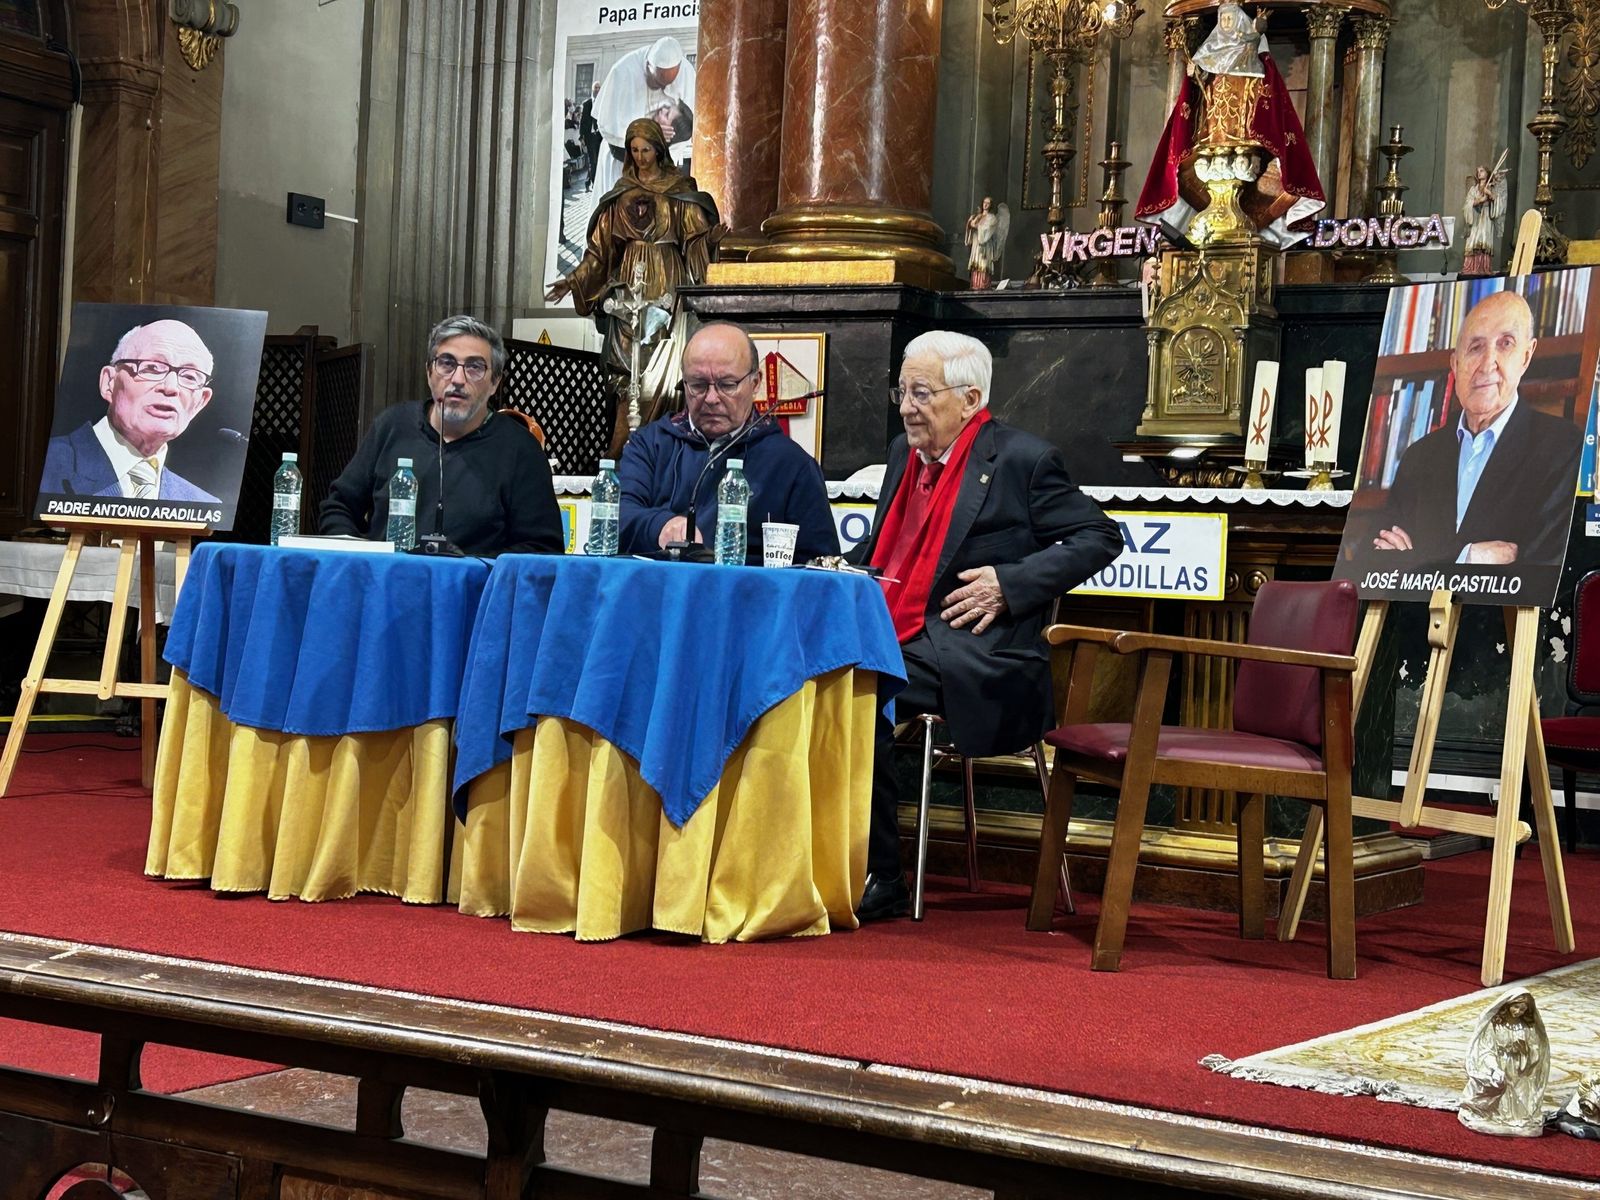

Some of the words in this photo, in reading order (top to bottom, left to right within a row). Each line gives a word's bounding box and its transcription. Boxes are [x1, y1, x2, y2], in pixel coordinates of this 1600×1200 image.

[599, 7, 637, 26] Papa
[1040, 225, 1158, 264] VIRGEN
[1306, 213, 1449, 247] DONGA
[47, 500, 92, 515] PADRE
[92, 503, 150, 518] ANTONIO
[151, 506, 222, 523] ARADILLAS
[1118, 521, 1171, 554] AZ
[765, 550, 793, 561] coffee
[1360, 569, 1400, 590] JOSÉ
[1400, 570, 1445, 591] MARÍA
[1448, 574, 1522, 595] CASTILLO
